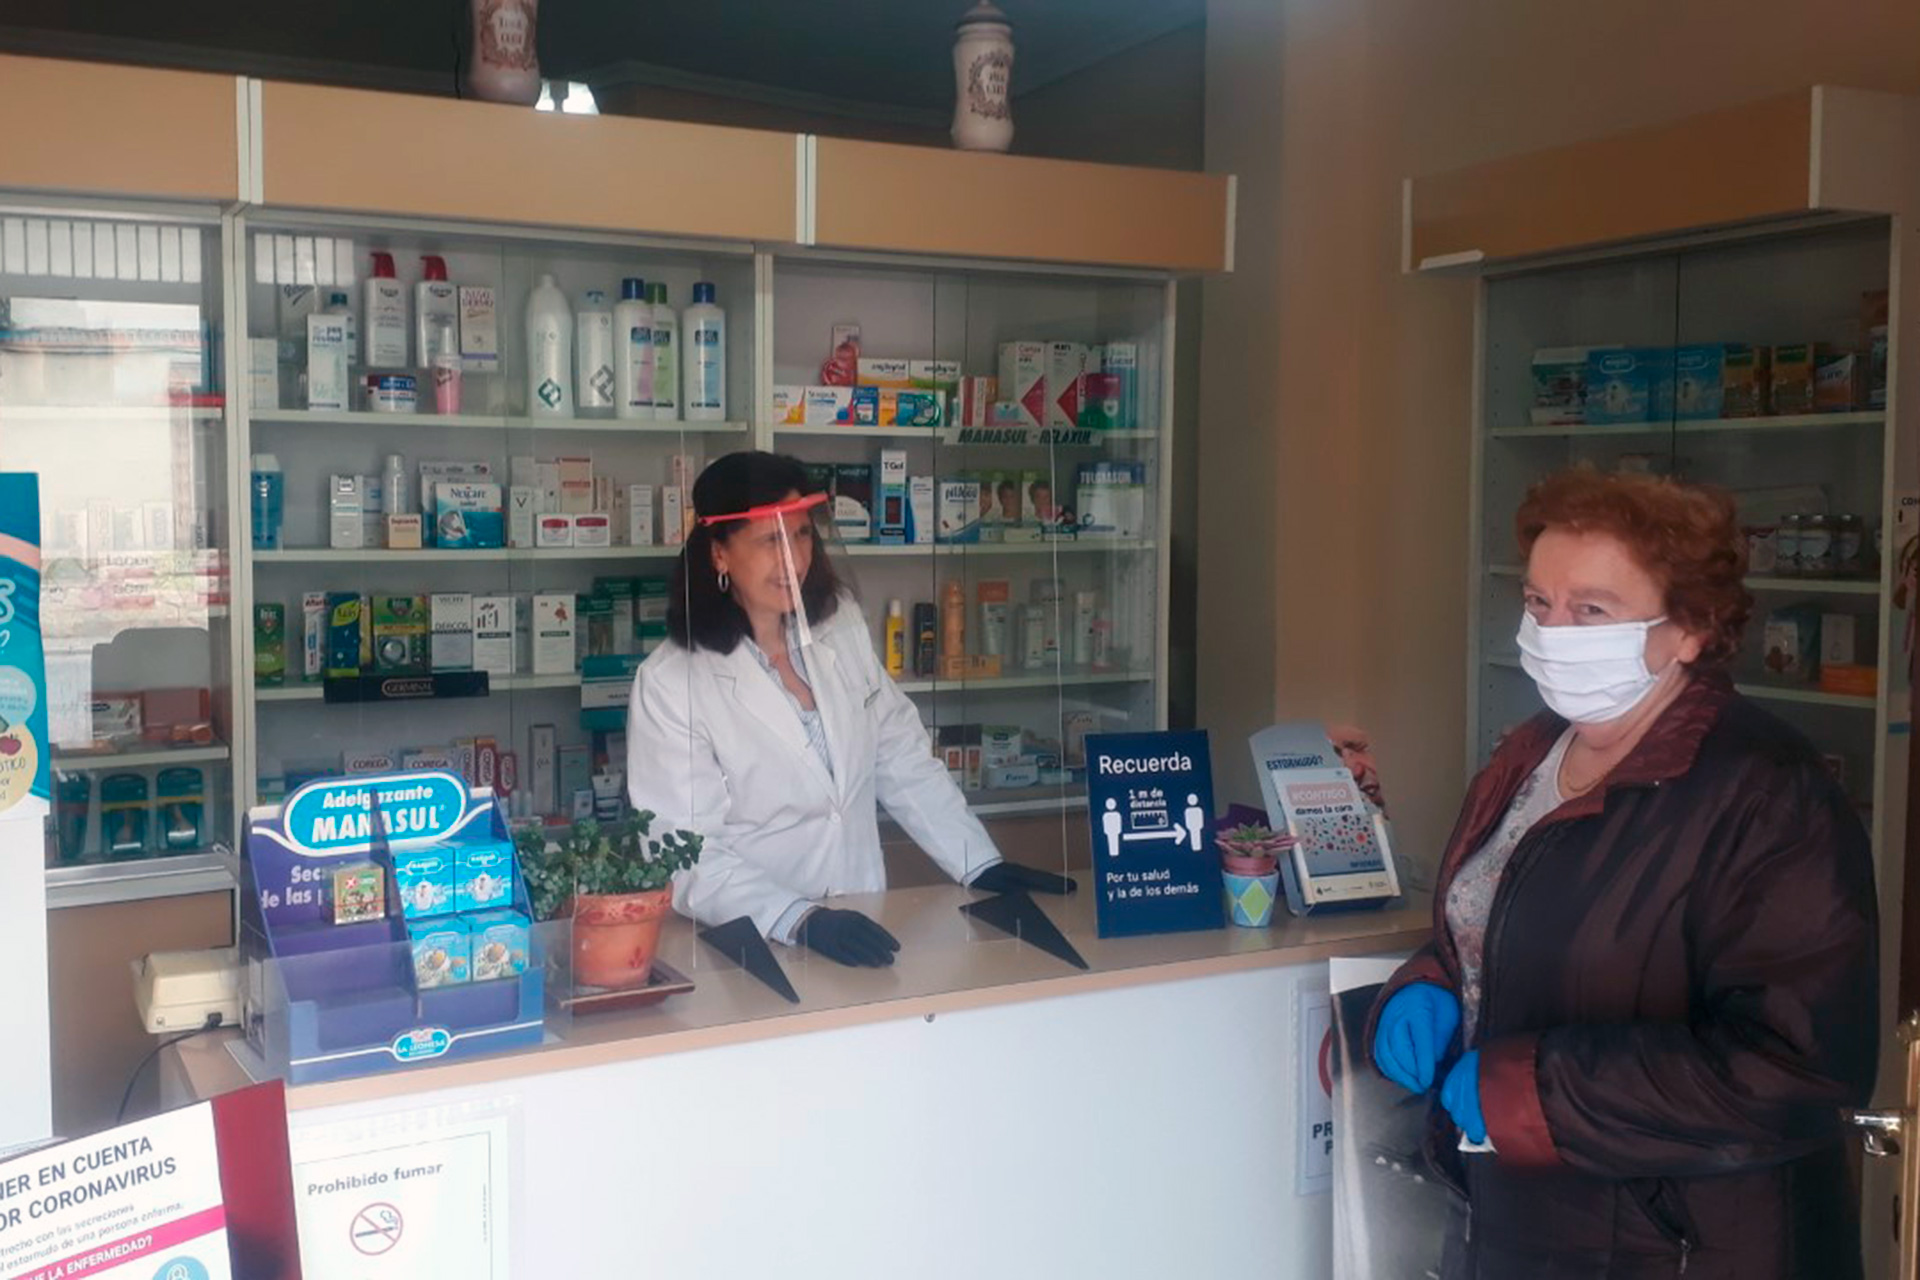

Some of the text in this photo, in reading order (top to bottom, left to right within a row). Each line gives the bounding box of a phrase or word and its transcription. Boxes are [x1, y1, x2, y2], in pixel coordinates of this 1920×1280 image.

[958, 430, 1028, 445] MANASUL
[353, 759, 389, 770] COREGA
[411, 759, 448, 769] COREGA
[1099, 752, 1193, 775] Recuerda
[1128, 788, 1164, 800] 1 m de
[1130, 799, 1167, 809] distancia
[1296, 804, 1353, 816] damos la cara
[291, 864, 325, 884] Sec
[1106, 869, 1171, 884] Por tu salud
[286, 886, 312, 906] las
[1107, 881, 1200, 901] y la de los demás
[38, 1162, 66, 1187] EN
[73, 1136, 153, 1175] CUENTA
[29, 1157, 177, 1219] CORONAVIRUS
[307, 1163, 444, 1197] Prohibido fumar
[7, 1245, 59, 1270] estornudo
[61, 1238, 74, 1250] de
[77, 1232, 96, 1245] una
[99, 1217, 139, 1239] persona
[35, 1231, 54, 1244] con
[57, 1225, 72, 1236] las
[47, 1234, 154, 1280] LA ENFERMEDAD?
